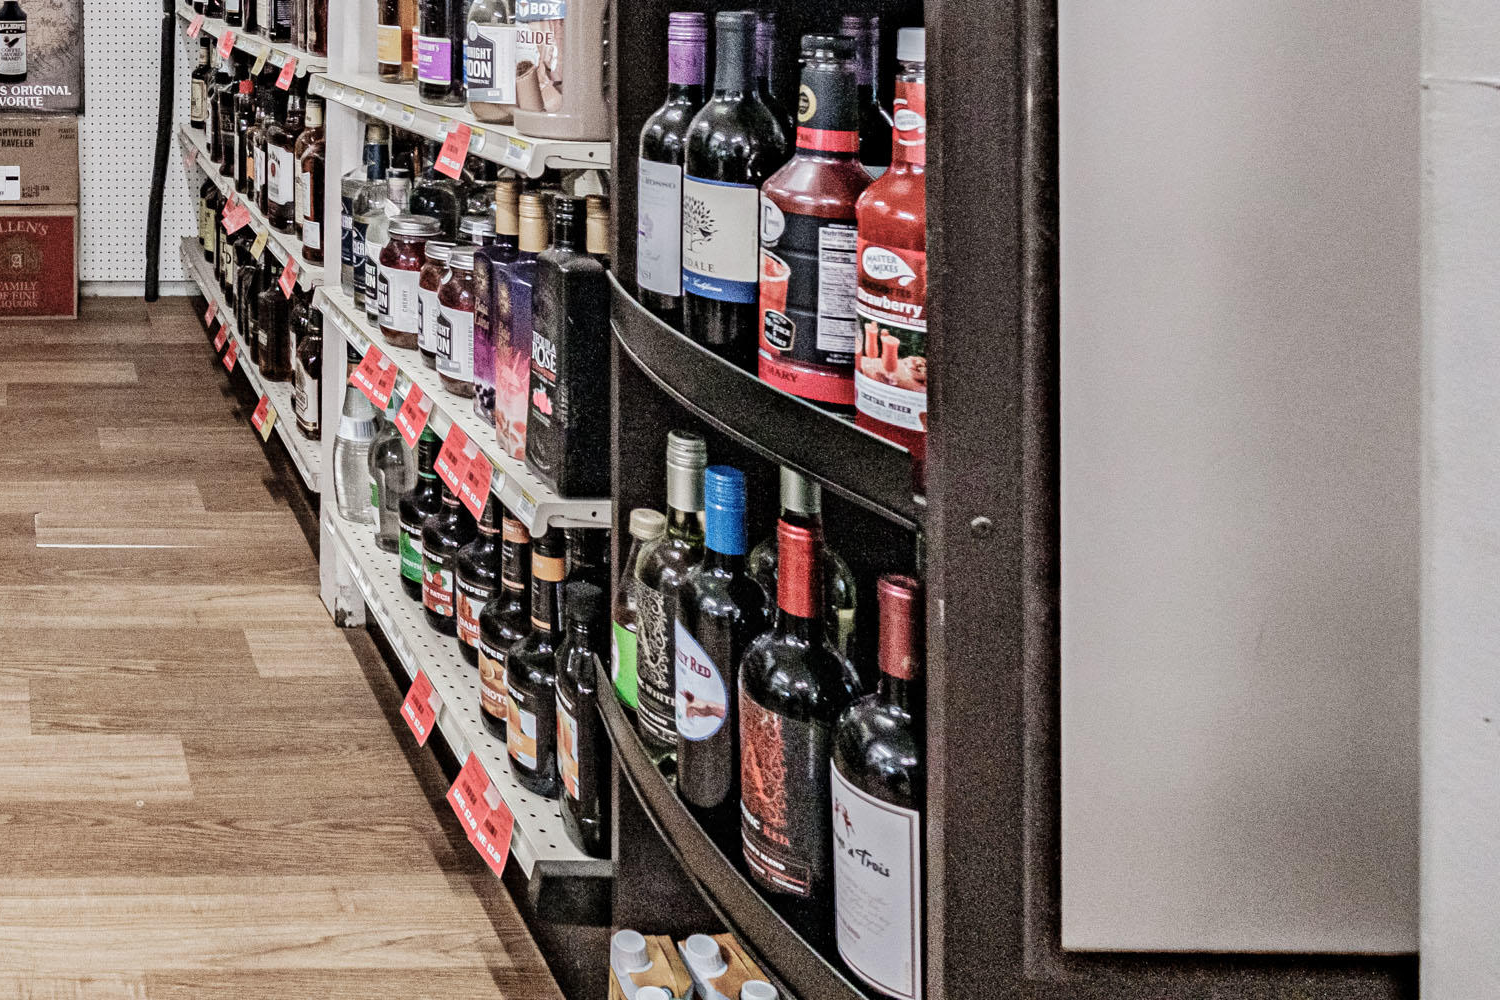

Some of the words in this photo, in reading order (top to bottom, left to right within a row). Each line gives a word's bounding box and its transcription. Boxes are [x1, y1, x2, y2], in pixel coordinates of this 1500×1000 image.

[531, 3, 560, 16] BOX
[10, 85, 72, 96] ORIGINAL
[13, 291, 38, 300] FINE
[532, 341, 557, 374] ROSE
[856, 848, 890, 878] Trois
